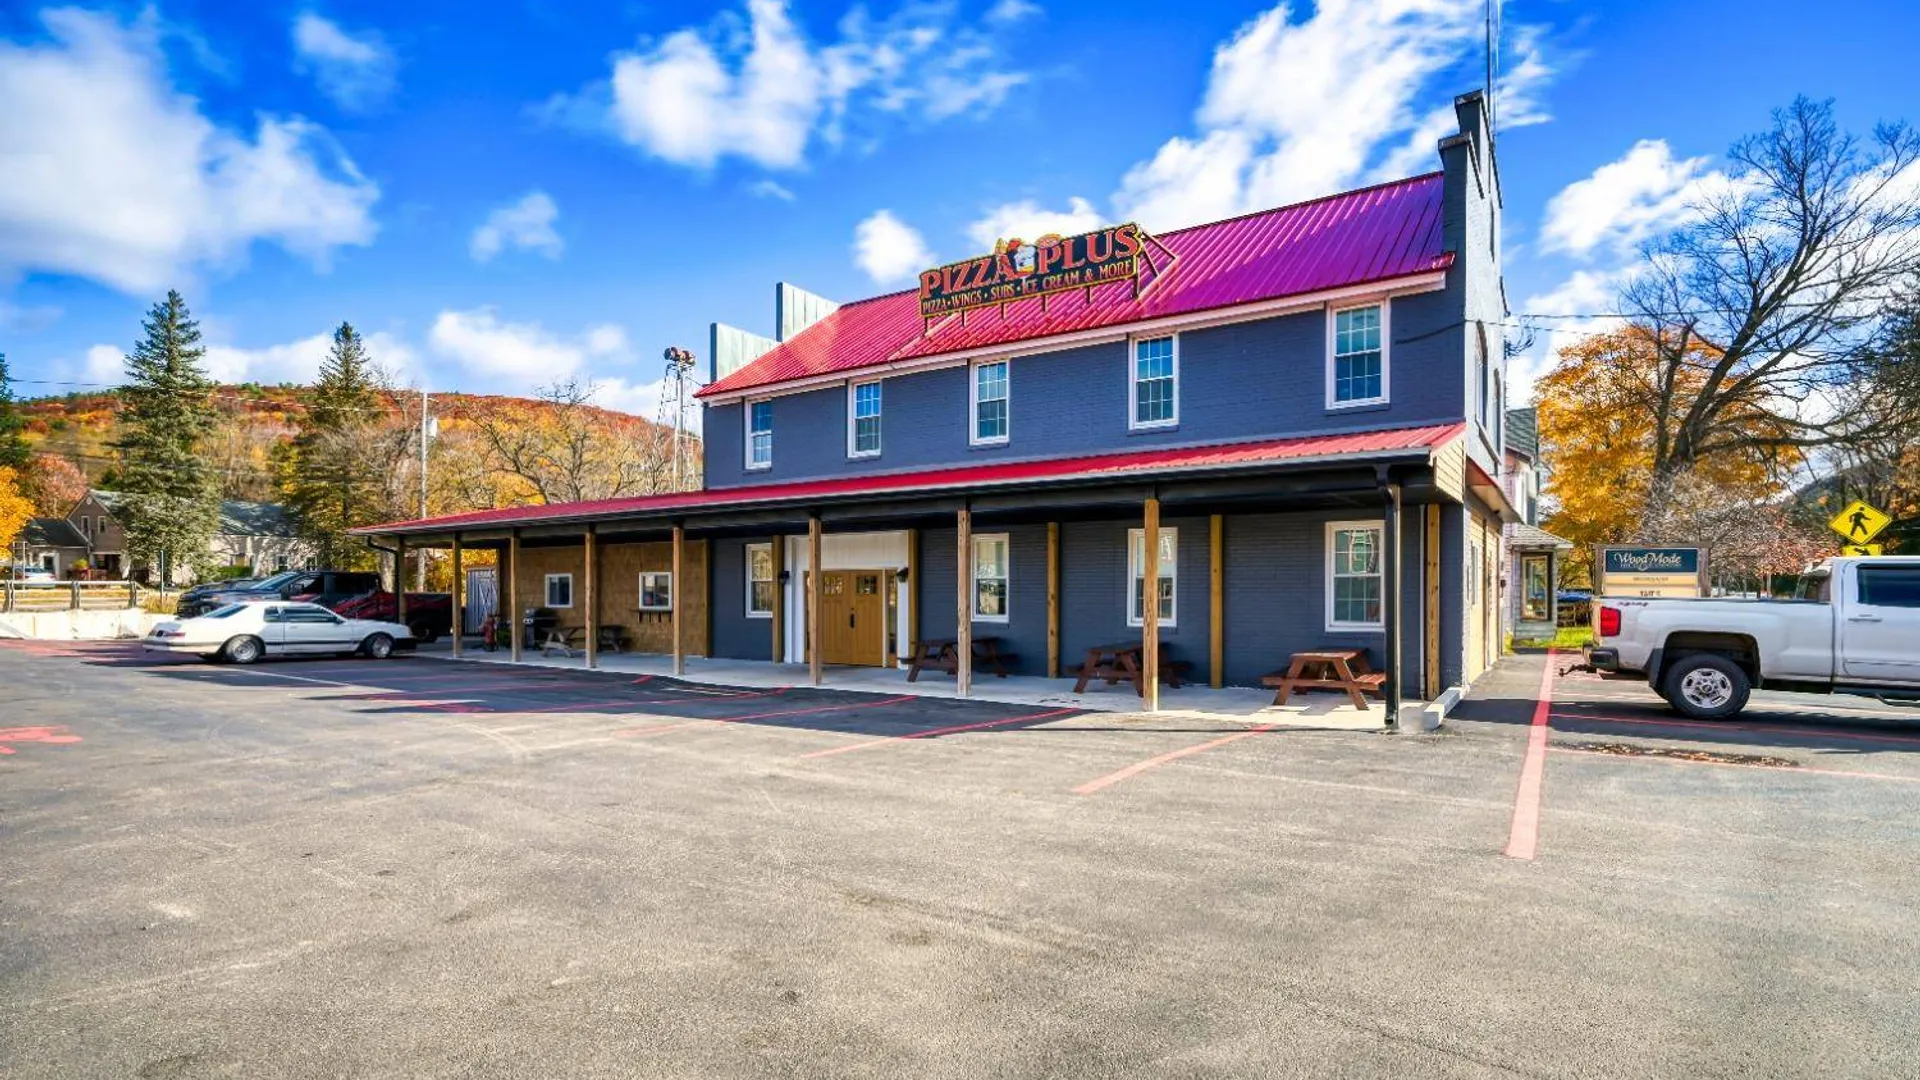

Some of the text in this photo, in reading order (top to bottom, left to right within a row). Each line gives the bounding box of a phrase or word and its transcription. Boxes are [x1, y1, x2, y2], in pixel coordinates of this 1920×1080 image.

[920, 226, 1138, 299] PIZZA PLUS
[922, 260, 1132, 313] PIZZA WINGS SUBS ICE CREAM & MORE
